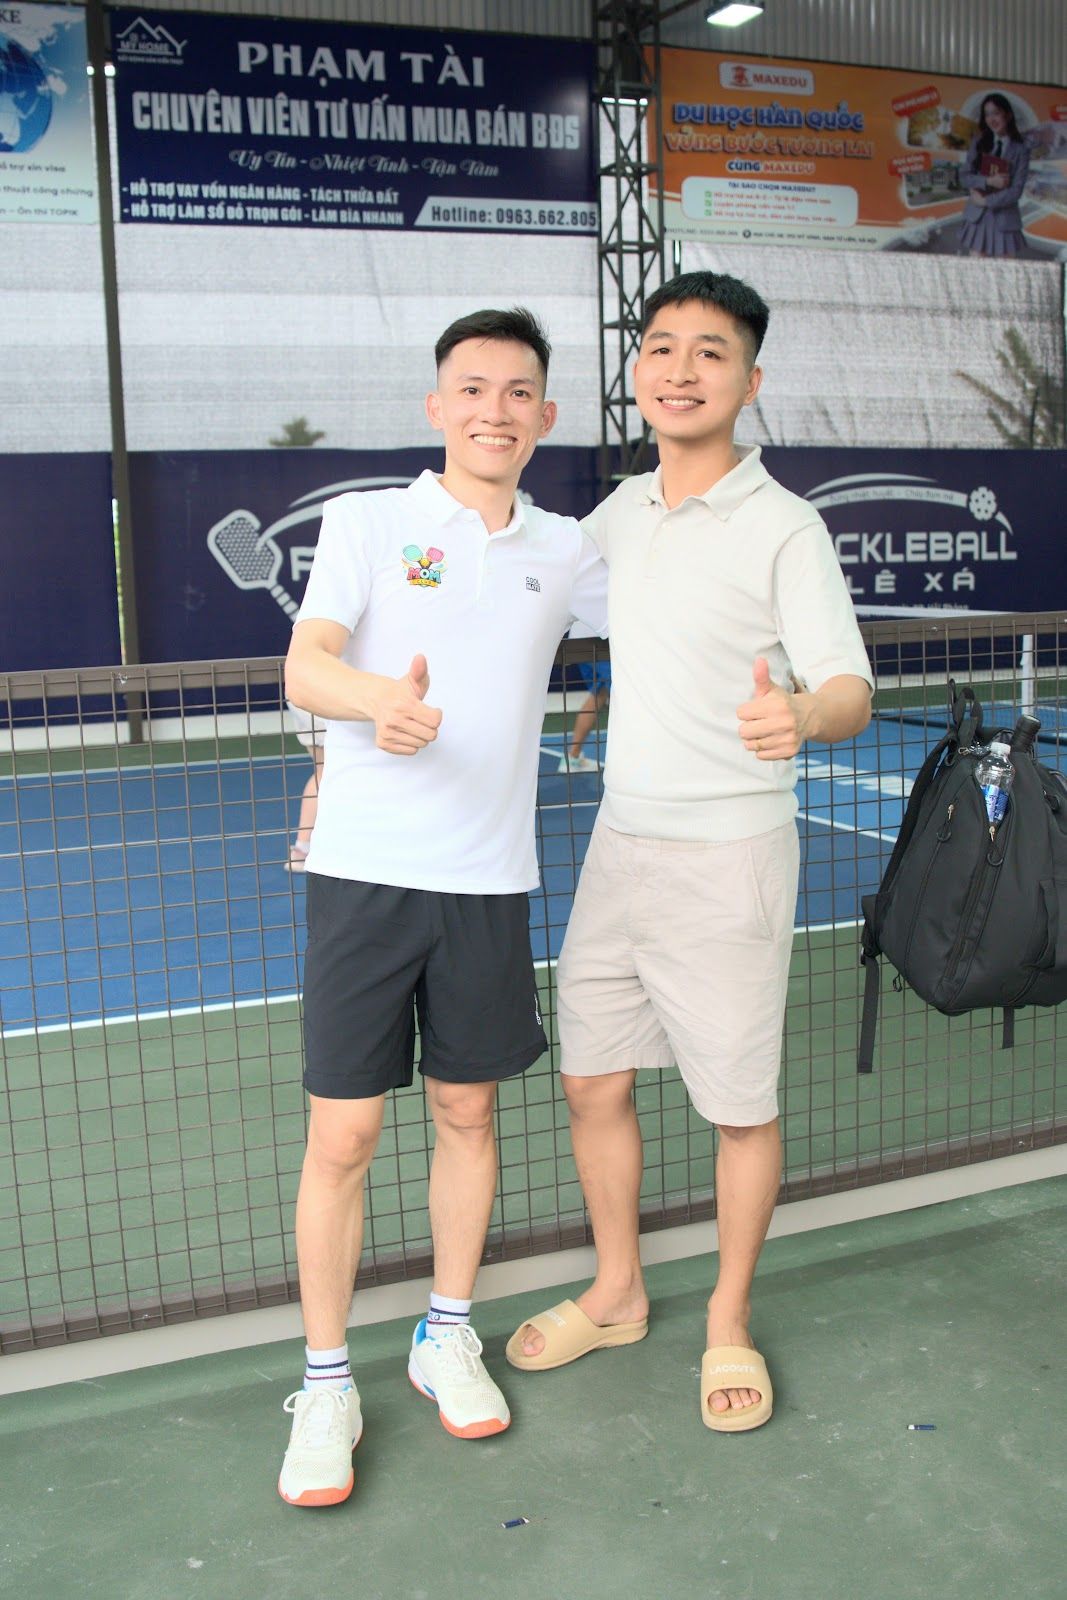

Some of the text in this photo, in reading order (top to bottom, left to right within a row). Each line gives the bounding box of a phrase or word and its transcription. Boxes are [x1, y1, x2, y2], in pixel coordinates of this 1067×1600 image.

[237, 41, 485, 88] PHẠM TÀI
[752, 73, 808, 89] MAXEDU
[132, 88, 580, 150] CHUYÊN VIÊN TƯ VẤN MUA BÁN BĐS
[674, 104, 706, 124] DU
[709, 105, 754, 130] HỌC
[807, 101, 865, 132] QUỐC
[129, 177, 149, 196] HỖ
[149, 181, 175, 201] TRỢ
[176, 183, 200, 198] VAY
[201, 180, 228, 199] VỐN
[229, 183, 266, 199] NGÂN
[266, 184, 301, 201] HÀNG
[310, 186, 341, 202] TÁCH
[343, 186, 375, 203] THỬA
[376, 187, 400, 205] ĐẤT
[130, 198, 150, 217] HỖ
[150, 202, 177, 221] TRỢ
[177, 202, 205, 218] LÀM
[245, 206, 279, 223] TRỌN
[280, 205, 303, 222] GÓI
[311, 207, 339, 223] LÀM
[340, 207, 361, 222] BÌA
[362, 210, 405, 225] NHANH
[432, 206, 597, 227] Hotline: 0963.662.805
[829, 530, 1018, 565] CKLEBALL
[407, 567, 442, 584] MOM
